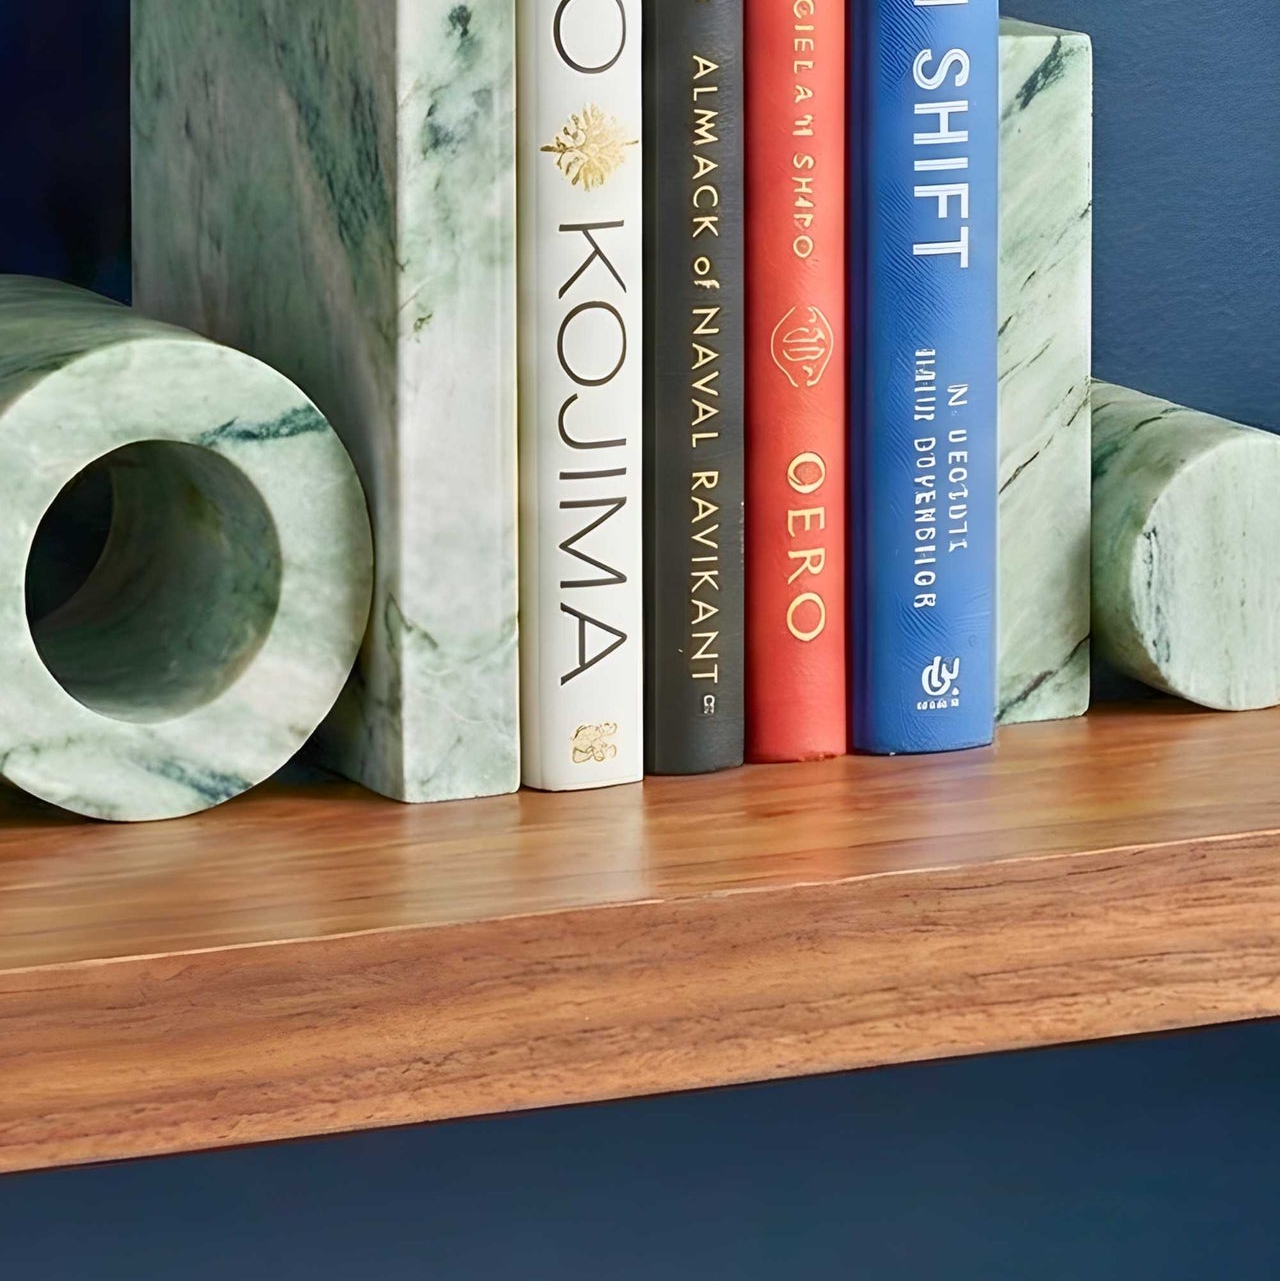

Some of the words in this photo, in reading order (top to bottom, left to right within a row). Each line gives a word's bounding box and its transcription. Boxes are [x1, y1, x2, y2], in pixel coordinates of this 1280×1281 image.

[912, 48, 971, 269] SHIFT
[691, 306, 721, 448] NAVAL
[693, 256, 721, 289] of
[556, 219, 628, 687] KOJIMA
[691, 470, 720, 684] RAVIKANT
